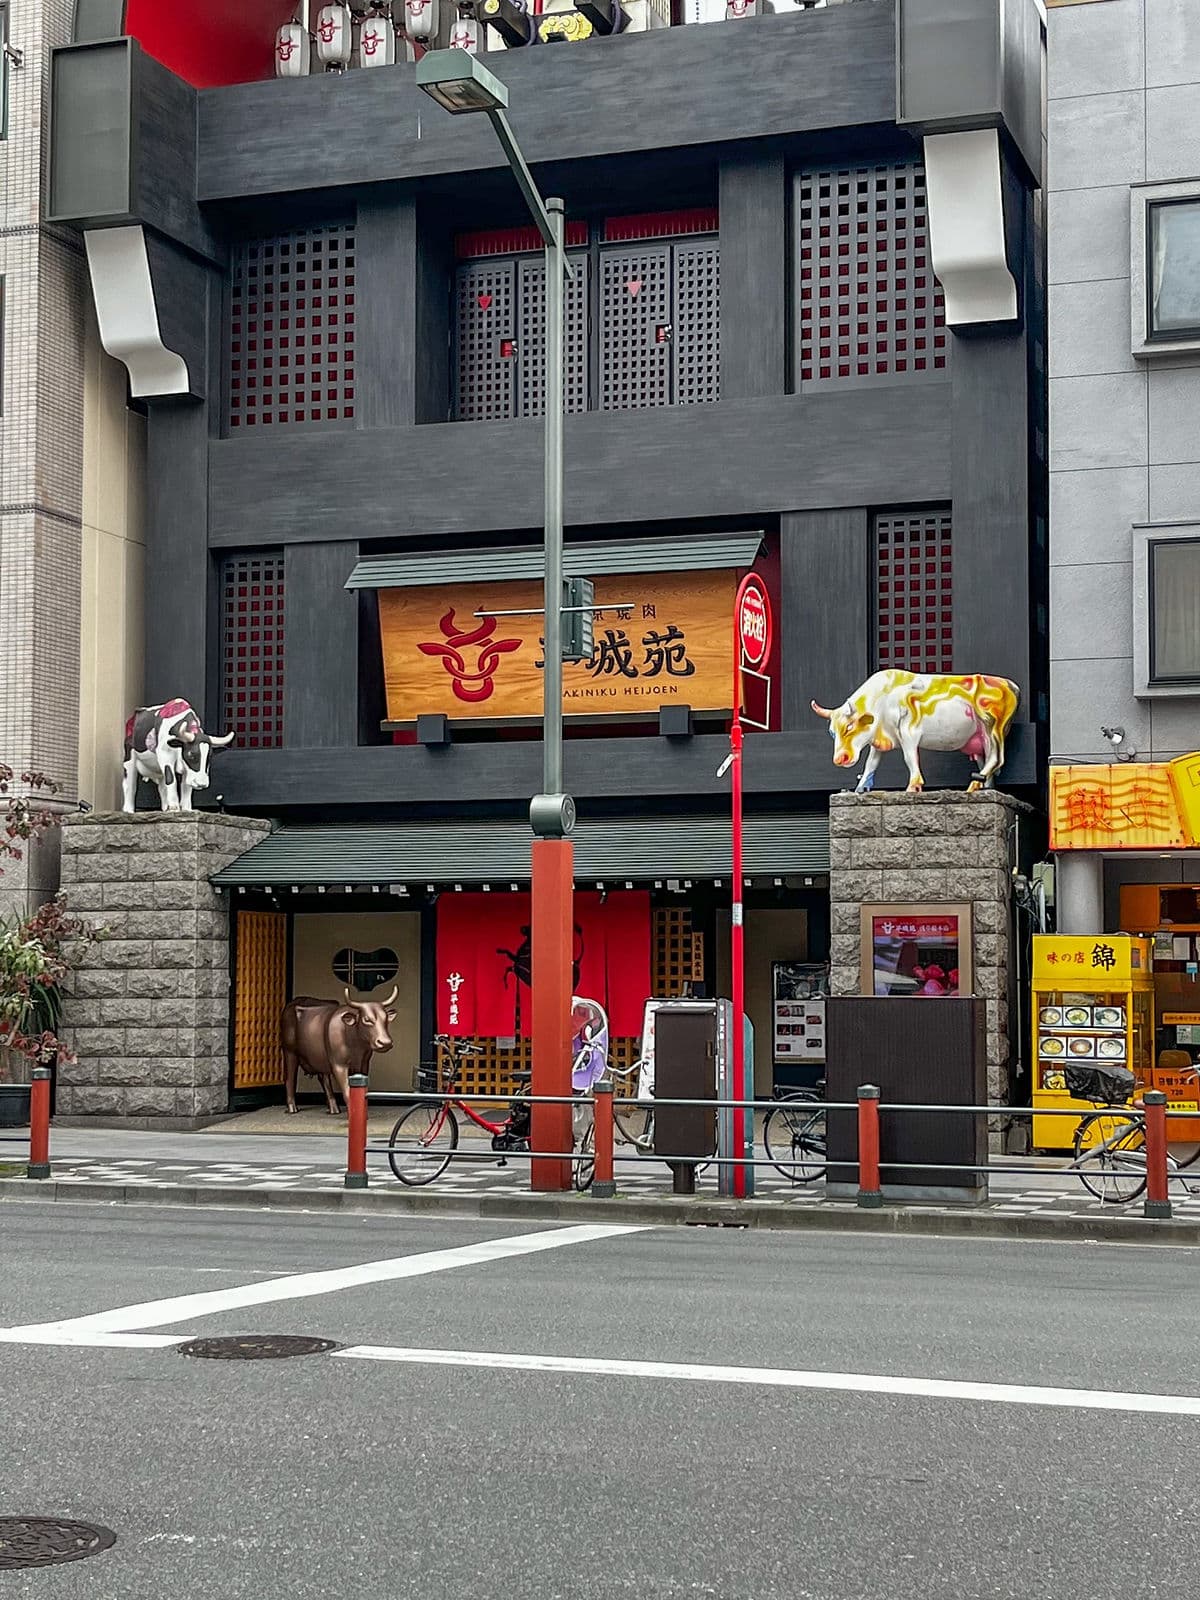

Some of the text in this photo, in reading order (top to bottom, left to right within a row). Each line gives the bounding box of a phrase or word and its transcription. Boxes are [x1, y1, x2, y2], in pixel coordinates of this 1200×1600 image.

[535, 625, 695, 678] 城苑
[562, 685, 678, 698] AKINIKU HEIJOEN
[1046, 943, 1117, 972] 味の店 錦
